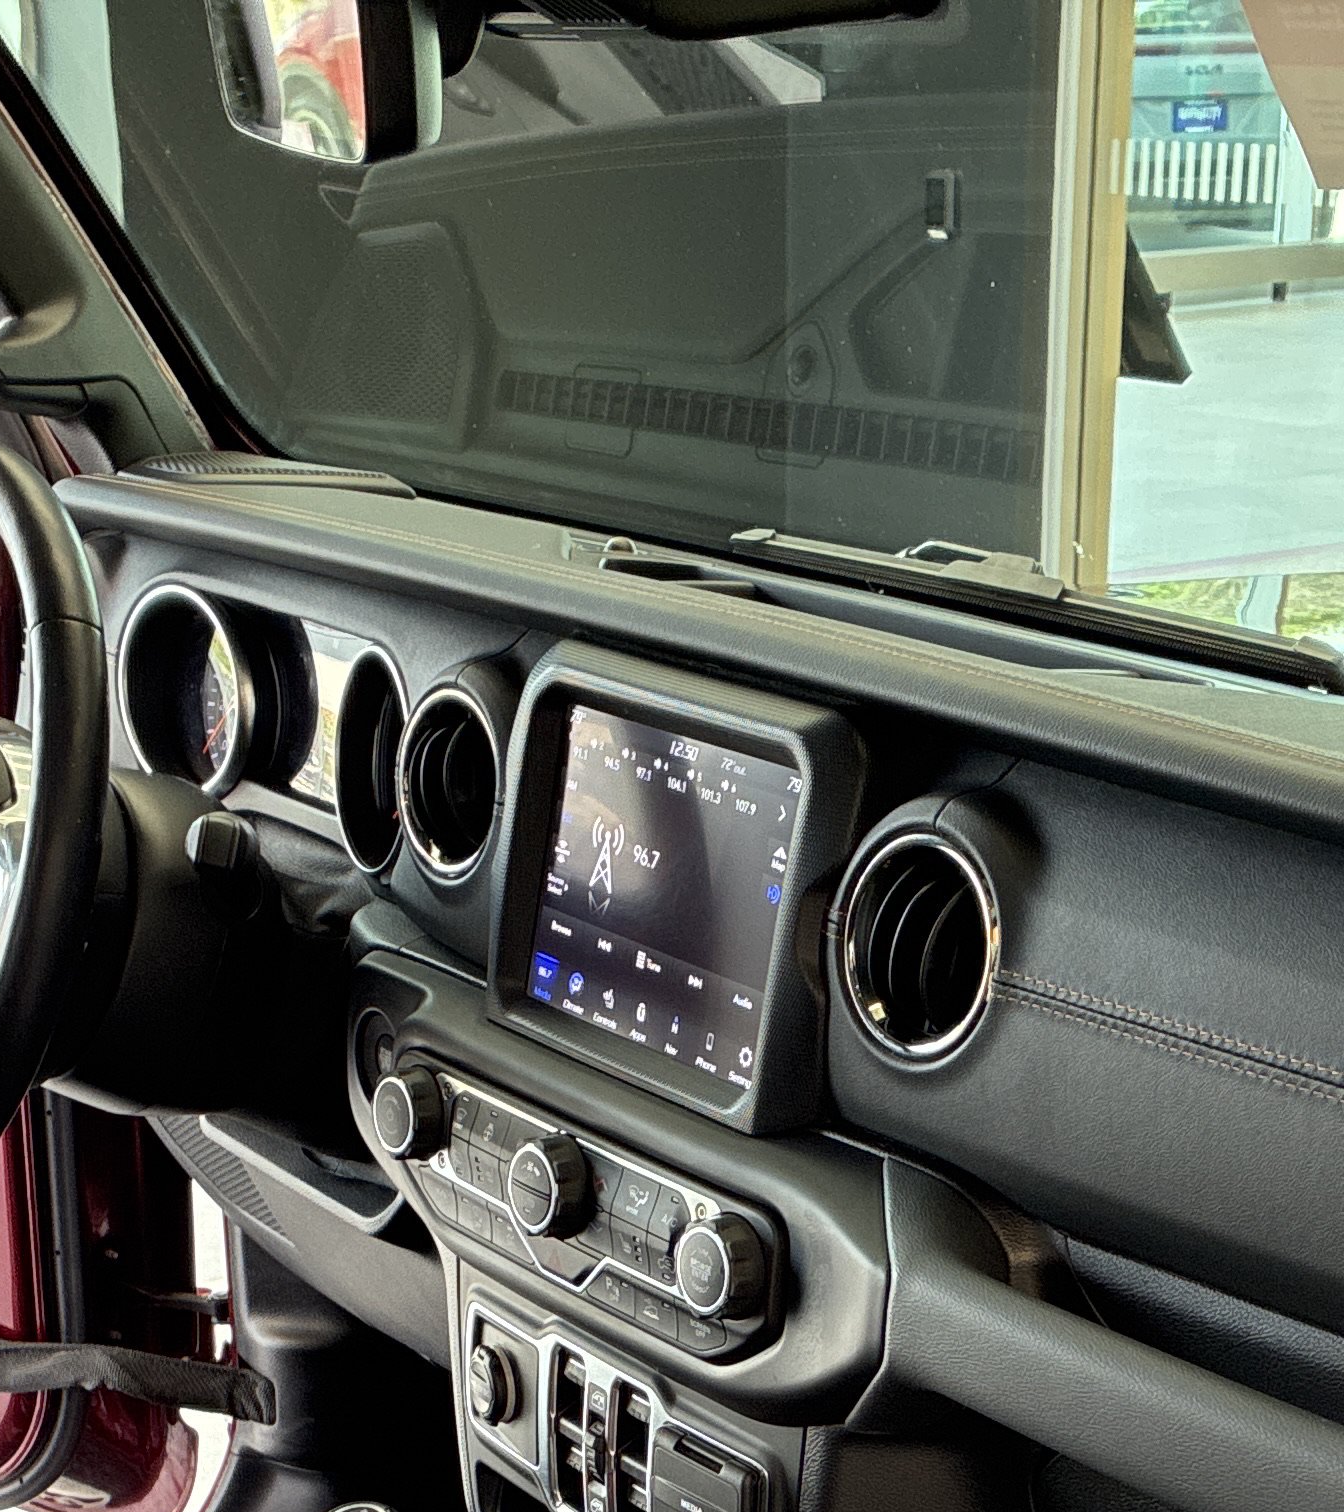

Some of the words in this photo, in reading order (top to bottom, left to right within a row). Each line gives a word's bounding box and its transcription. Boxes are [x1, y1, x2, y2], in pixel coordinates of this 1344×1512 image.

[669, 740, 699, 762] 12:50
[701, 787, 722, 804] 101.3
[736, 798, 756, 815] 107.9
[633, 844, 661, 869] 96.7
